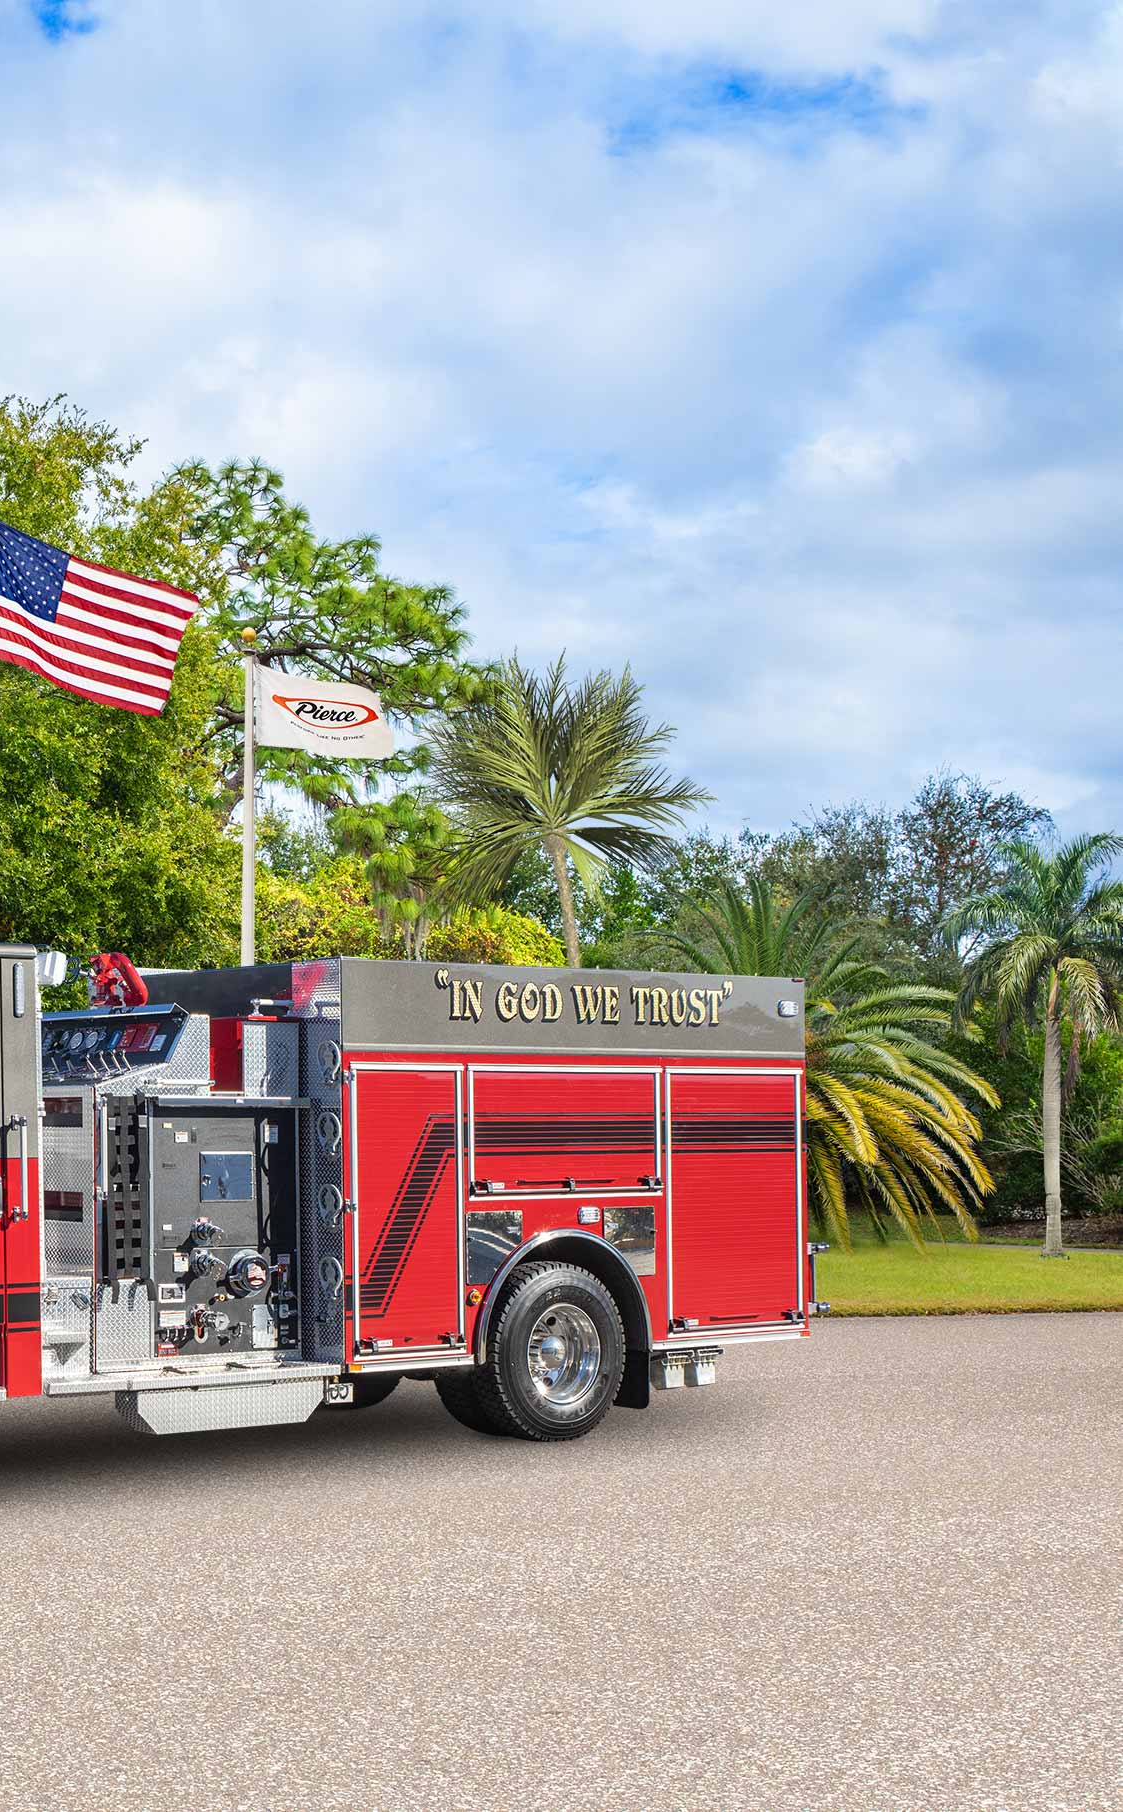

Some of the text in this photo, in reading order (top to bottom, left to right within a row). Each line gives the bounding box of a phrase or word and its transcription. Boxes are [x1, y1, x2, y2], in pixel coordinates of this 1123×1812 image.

[295, 701, 356, 722] Pierce
[495, 981, 564, 1025] GOD
[571, 984, 621, 1025] WE
